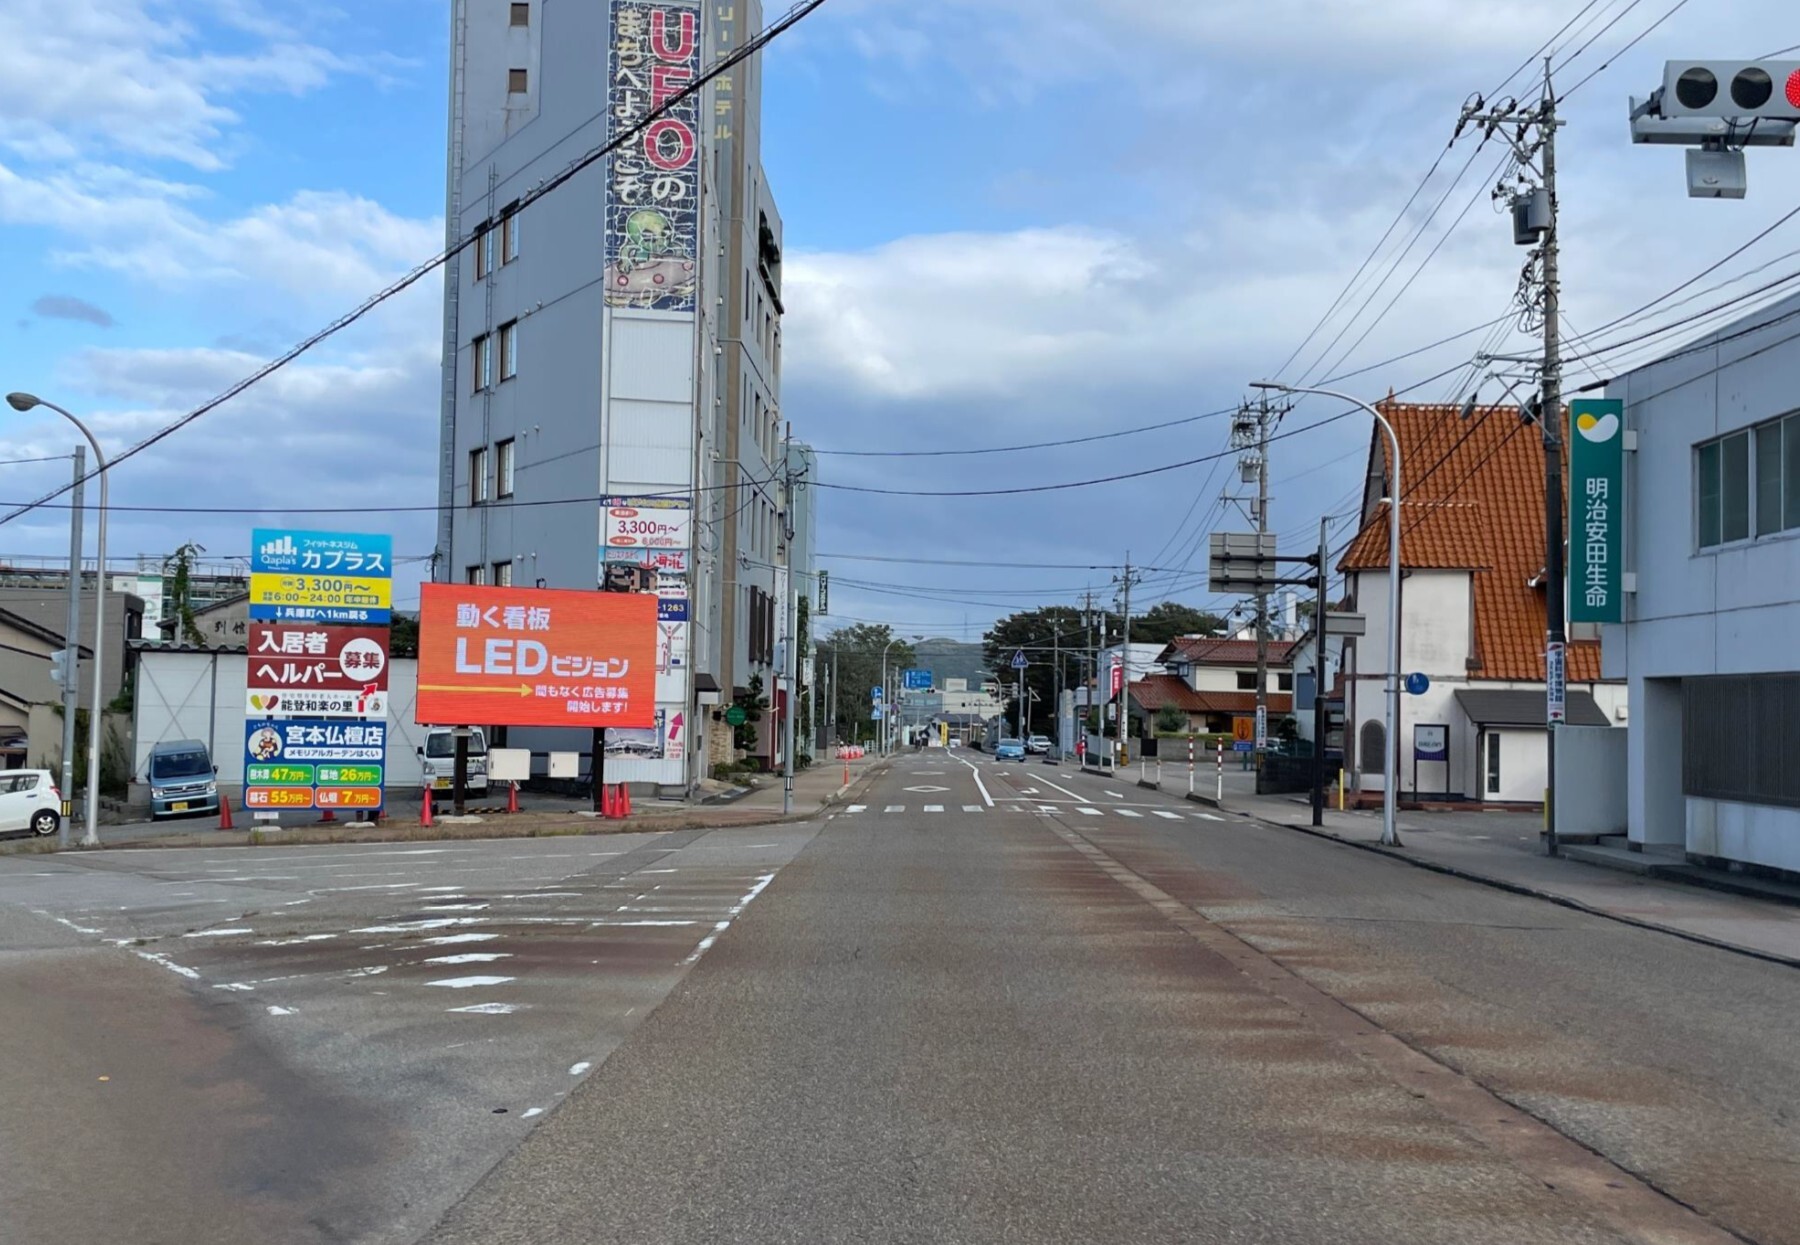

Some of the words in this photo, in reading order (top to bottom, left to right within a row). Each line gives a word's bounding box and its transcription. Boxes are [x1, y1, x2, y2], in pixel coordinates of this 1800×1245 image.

[303, 540, 358, 549] フィットネスジム
[1585, 478, 1608, 607] 明治安田生命
[302, 550, 385, 571] カプラス
[285, 607, 368, 620] 兵庫町へ1km戻る
[456, 603, 551, 631] 動く看板
[257, 630, 328, 655] 入居者
[344, 651, 380, 669] 募集
[256, 663, 343, 684] ヘルパー
[281, 700, 353, 712] 能登和楽の里
[289, 749, 378, 758] メモリアルガーデンはくい
